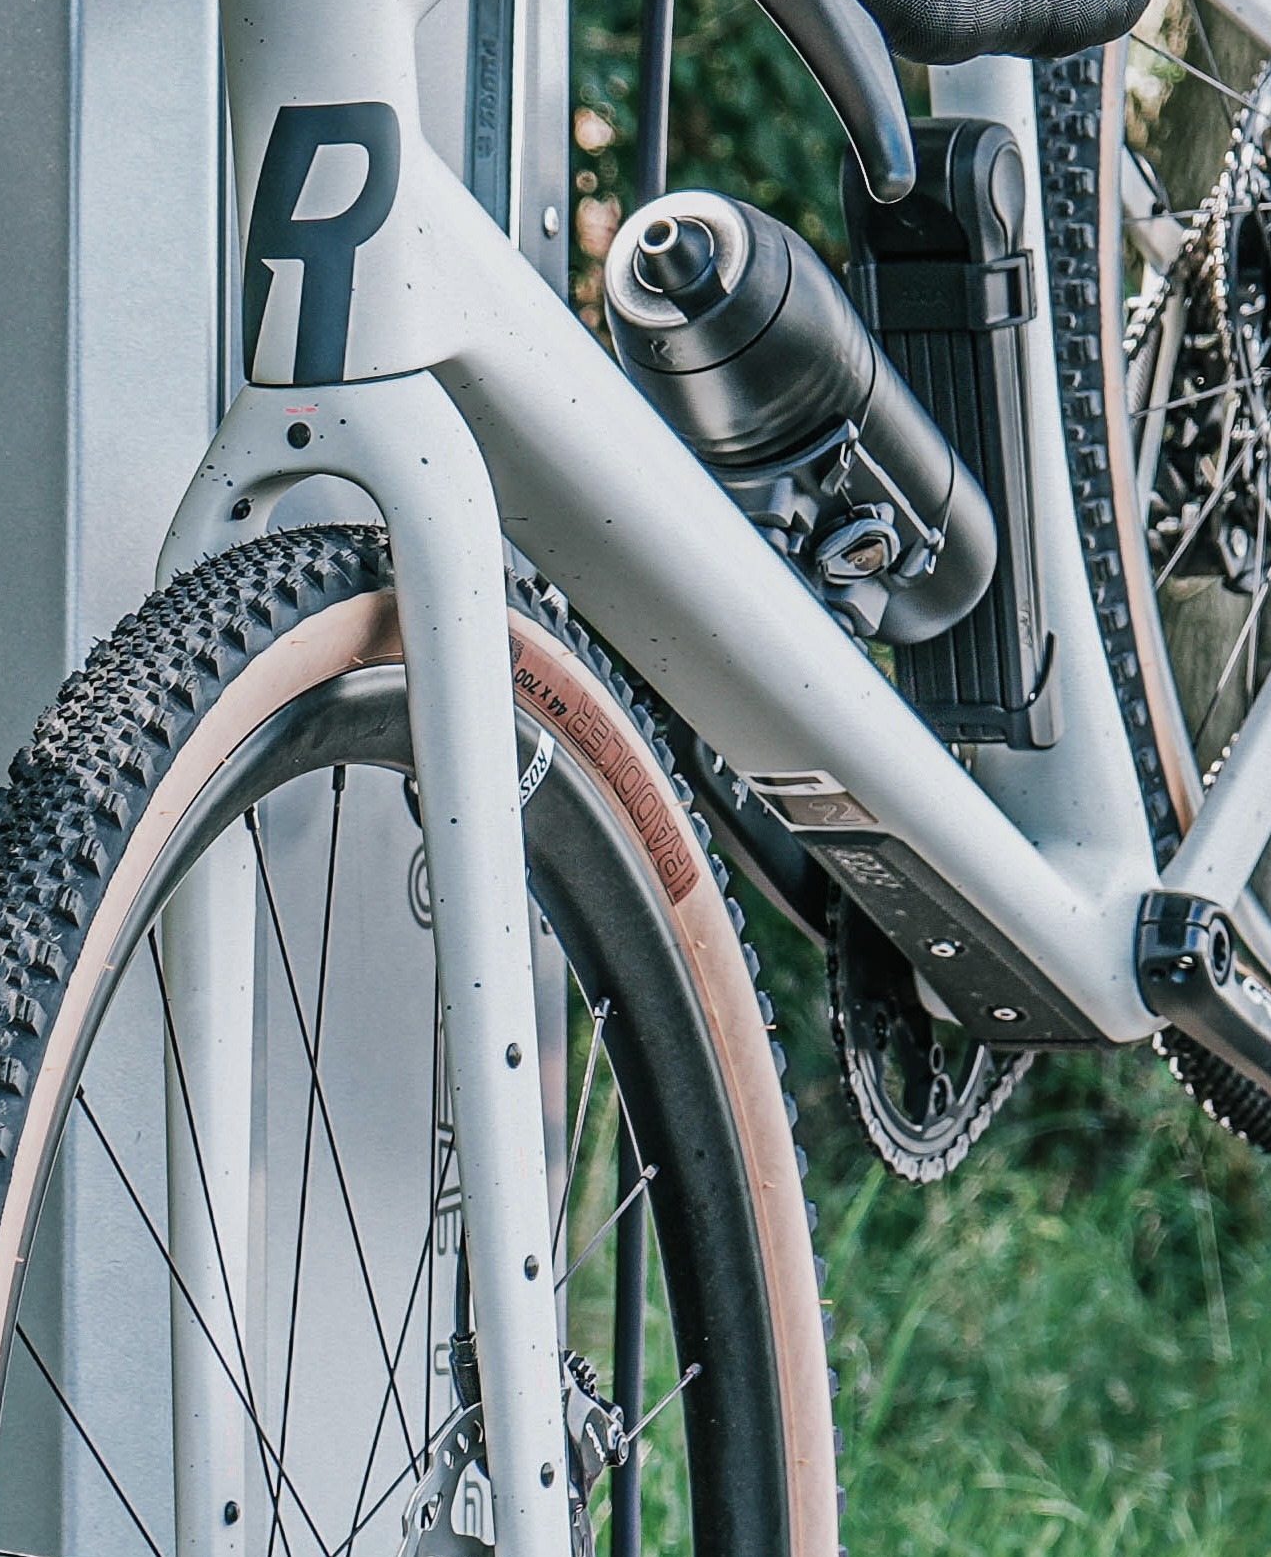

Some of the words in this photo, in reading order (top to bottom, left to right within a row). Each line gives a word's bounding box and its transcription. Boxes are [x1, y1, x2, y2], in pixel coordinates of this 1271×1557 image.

[513, 668, 542, 695] 700
[547, 695, 567, 717] 44
[520, 746, 547, 802] ROS
[566, 691, 691, 887] RADDLER
